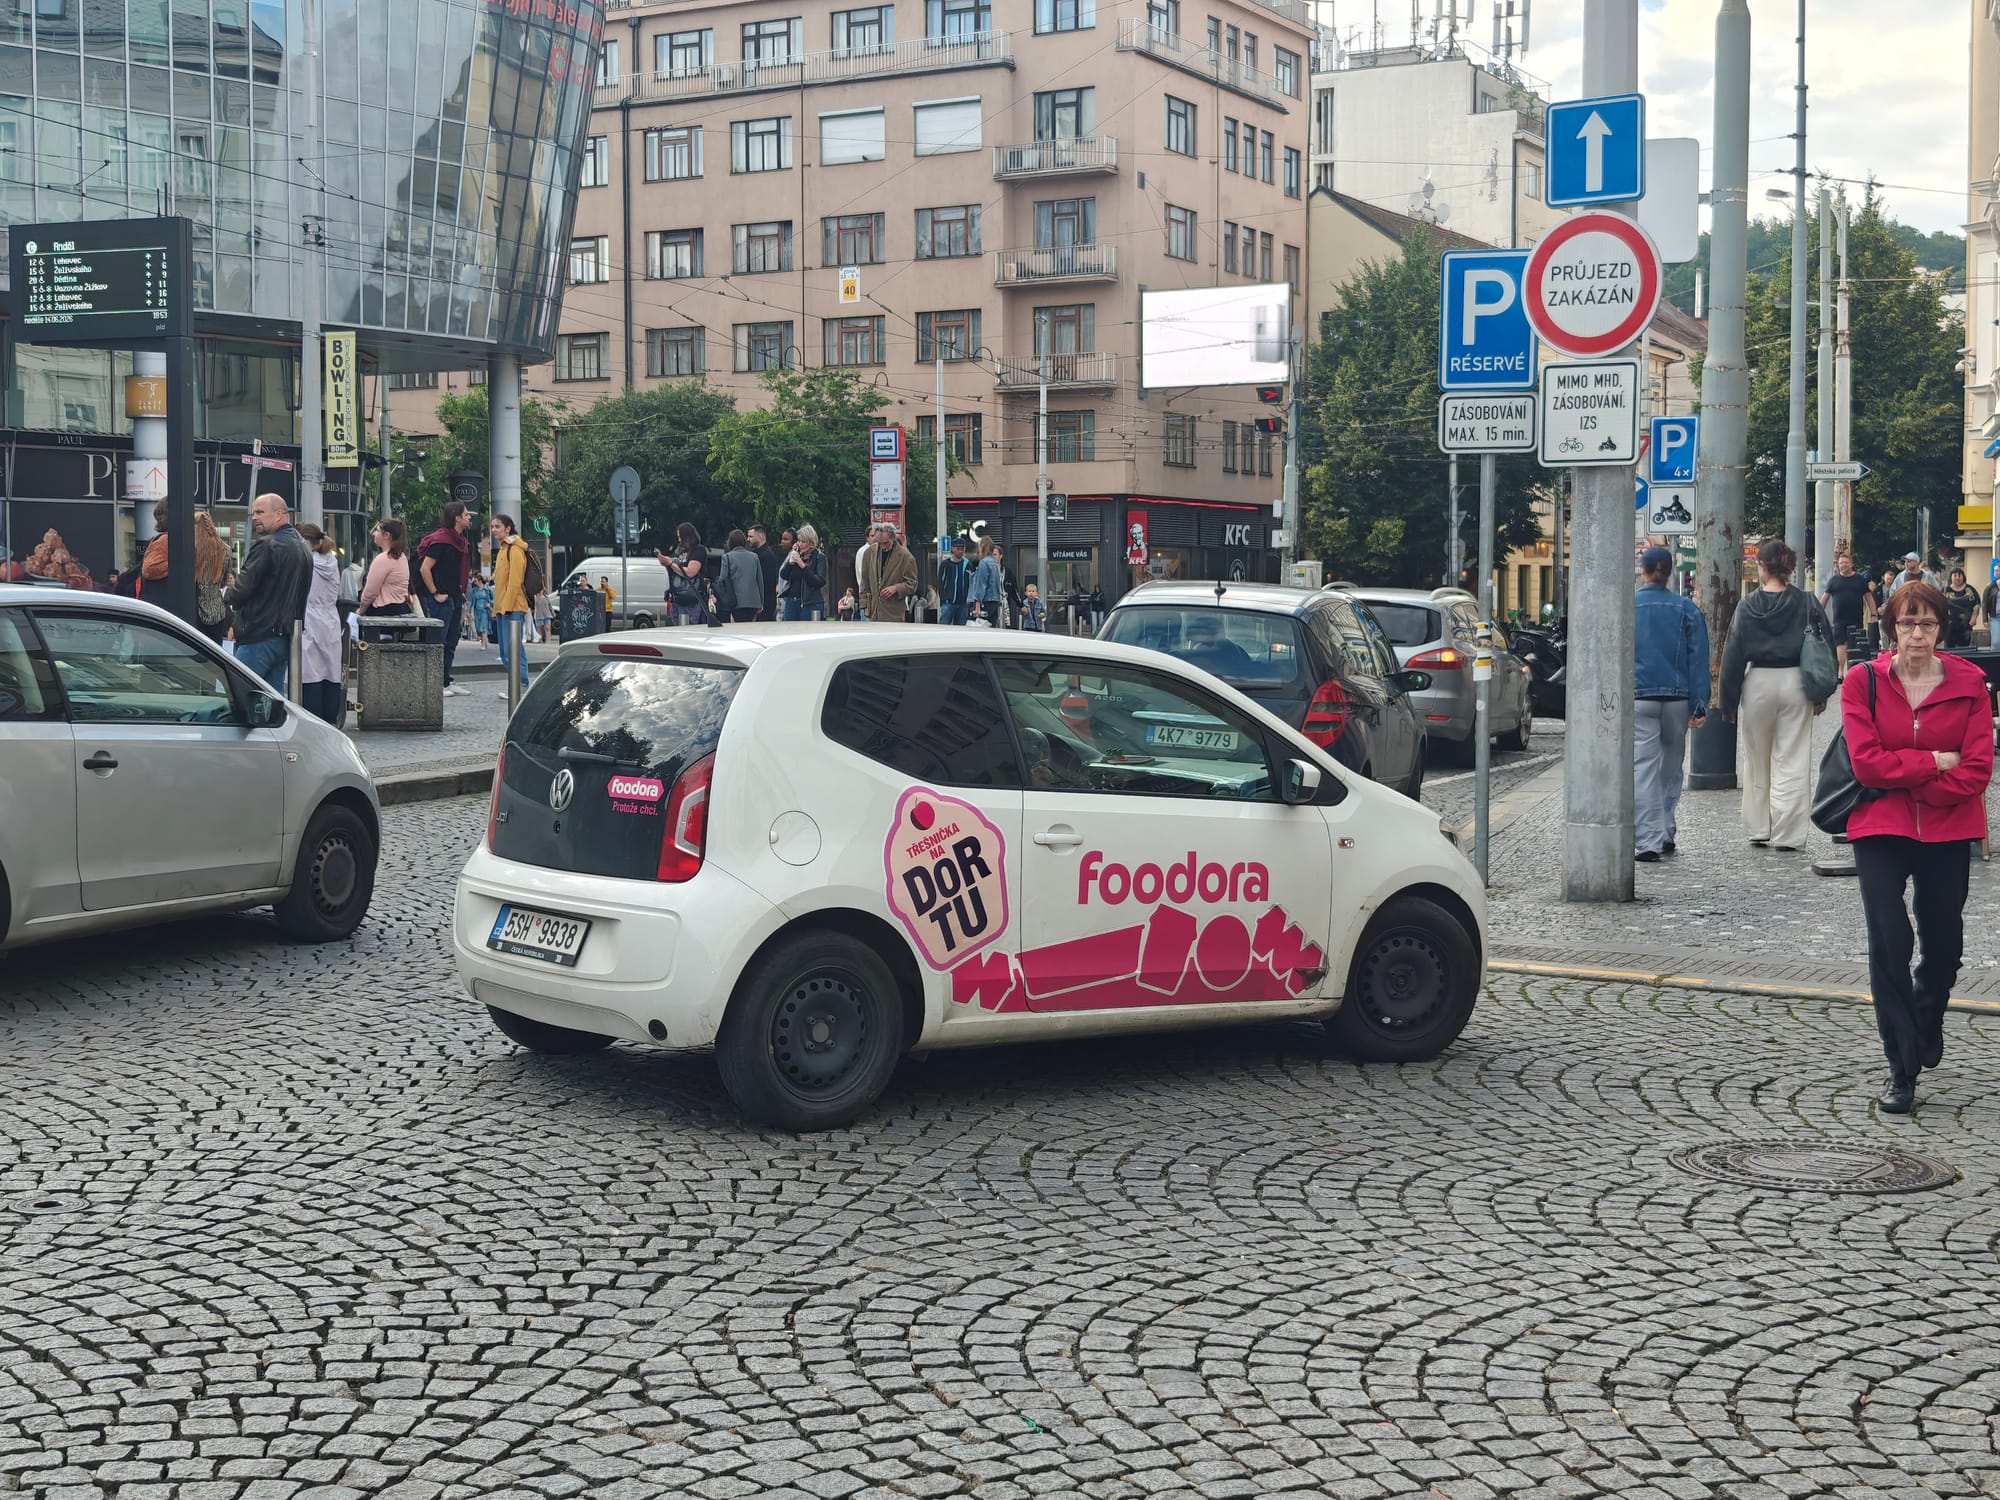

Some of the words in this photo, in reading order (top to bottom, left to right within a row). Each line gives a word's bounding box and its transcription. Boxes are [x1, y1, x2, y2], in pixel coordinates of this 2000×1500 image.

[29, 258, 37, 266] 12
[163, 252, 167, 260] 1
[29, 267, 37, 276] 15
[162, 261, 167, 270] 6
[1551, 259, 1632, 282] PRŮJEZD
[29, 276, 37, 285] 20
[162, 271, 167, 279] 9
[33, 285, 38, 294] 5
[159, 280, 166, 288] 11
[29, 295, 38, 303] 12
[844, 285, 856, 296] 40
[1547, 286, 1634, 307] ZAKÁZÁN
[29, 304, 38, 312] 15
[158, 299, 167, 307] 21
[1462, 269, 1516, 346] P
[1450, 352, 1525, 373] RÉSERVÉ
[331, 339, 346, 442] BOWLING
[1557, 374, 1588, 389] MIMO
[1451, 402, 1527, 421] ZÁSOBOVÁNÍ
[1580, 416, 1597, 430] IZS
[57, 434, 85, 446] PAUL
[1448, 427, 1478, 444] MAX.
[1486, 427, 1498, 442] 15
[1503, 427, 1528, 443] min.
[1660, 424, 1688, 463] P
[1224, 523, 1250, 546] KFC
[1053, 548, 1075, 559] VÍTÁME
[1076, 548, 1088, 558] VÁS
[1129, 557, 1147, 565] KFC
[1158, 727, 1185, 743] 4K7
[1195, 731, 1231, 748] 9779
[611, 778, 659, 798] foodora
[612, 801, 638, 814] Protože
[640, 804, 658, 816] chci.
[906, 822, 960, 860] TŘEŠNIČKA
[929, 845, 946, 860] NA
[902, 836, 992, 917] DOR
[1078, 850, 1270, 905] foodora
[929, 886, 988, 952] TU
[504, 912, 535, 941] 5SH
[538, 918, 578, 950] 9938
